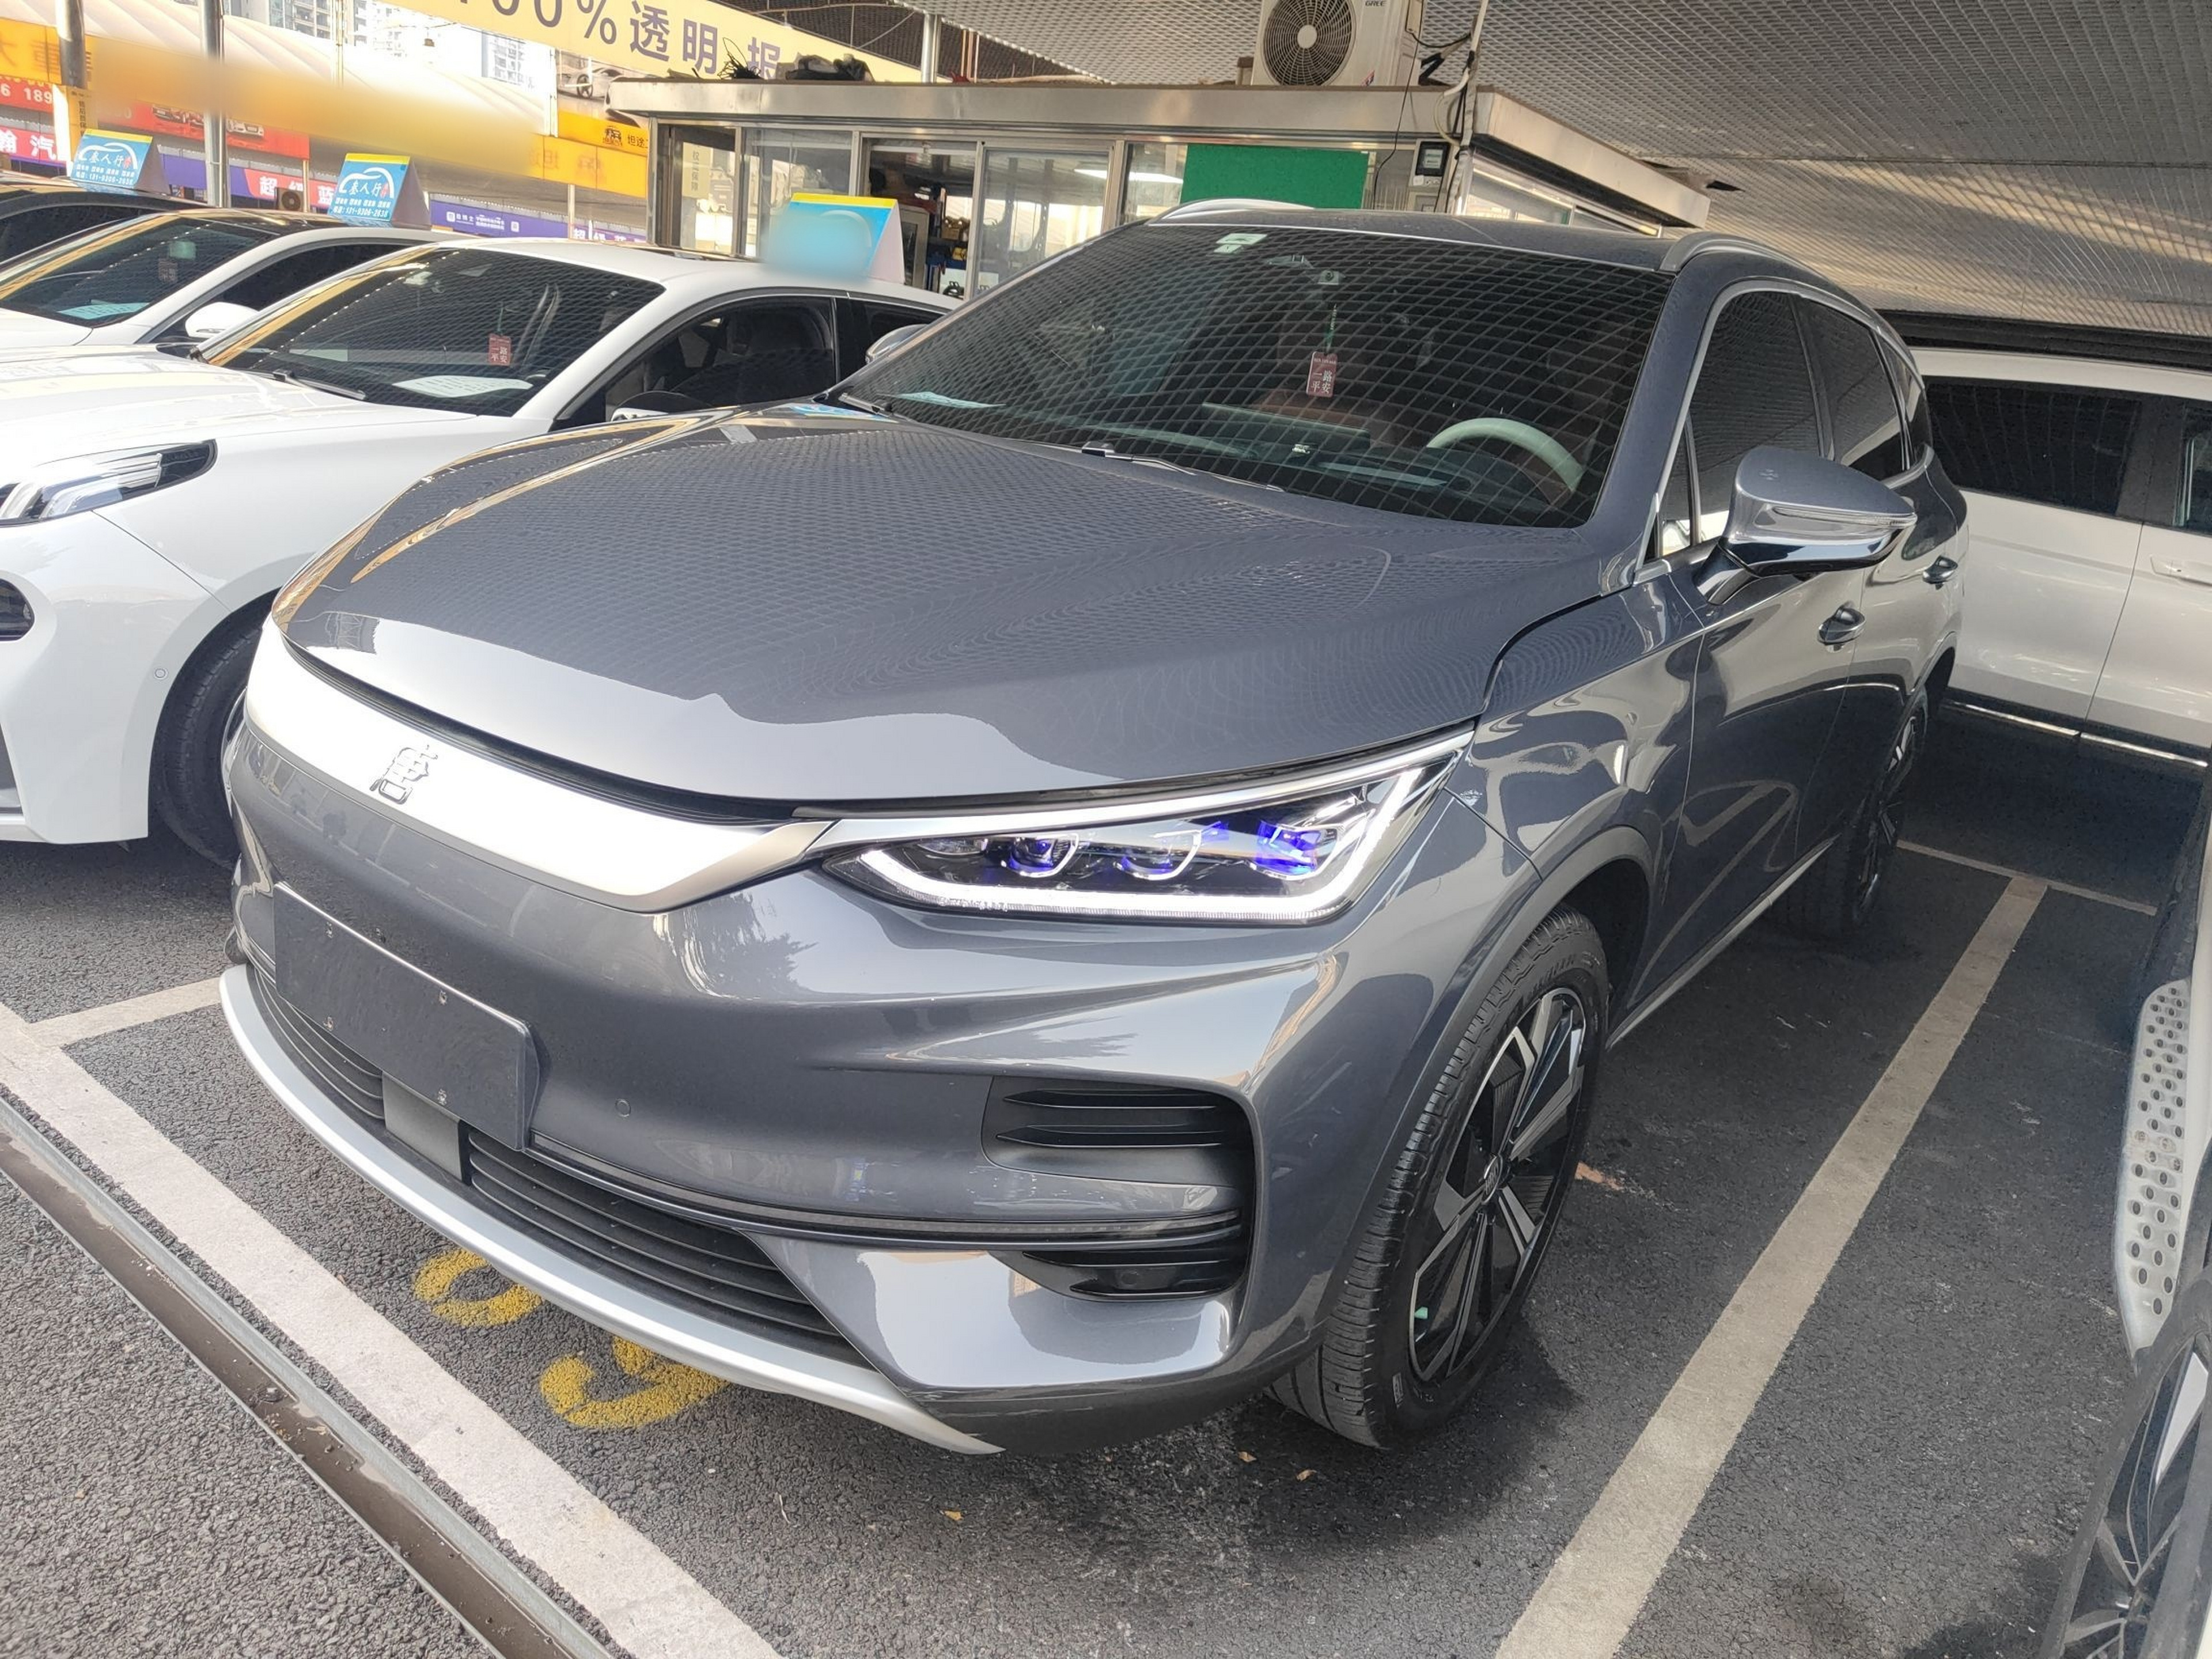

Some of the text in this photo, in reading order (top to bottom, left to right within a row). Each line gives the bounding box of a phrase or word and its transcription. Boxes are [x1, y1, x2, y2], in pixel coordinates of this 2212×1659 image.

[461, 0, 780, 79] 0%透明报
[627, 134, 648, 149] 坦途
[1313, 370, 1332, 382] 一路
[1310, 381, 1331, 394] 平安
